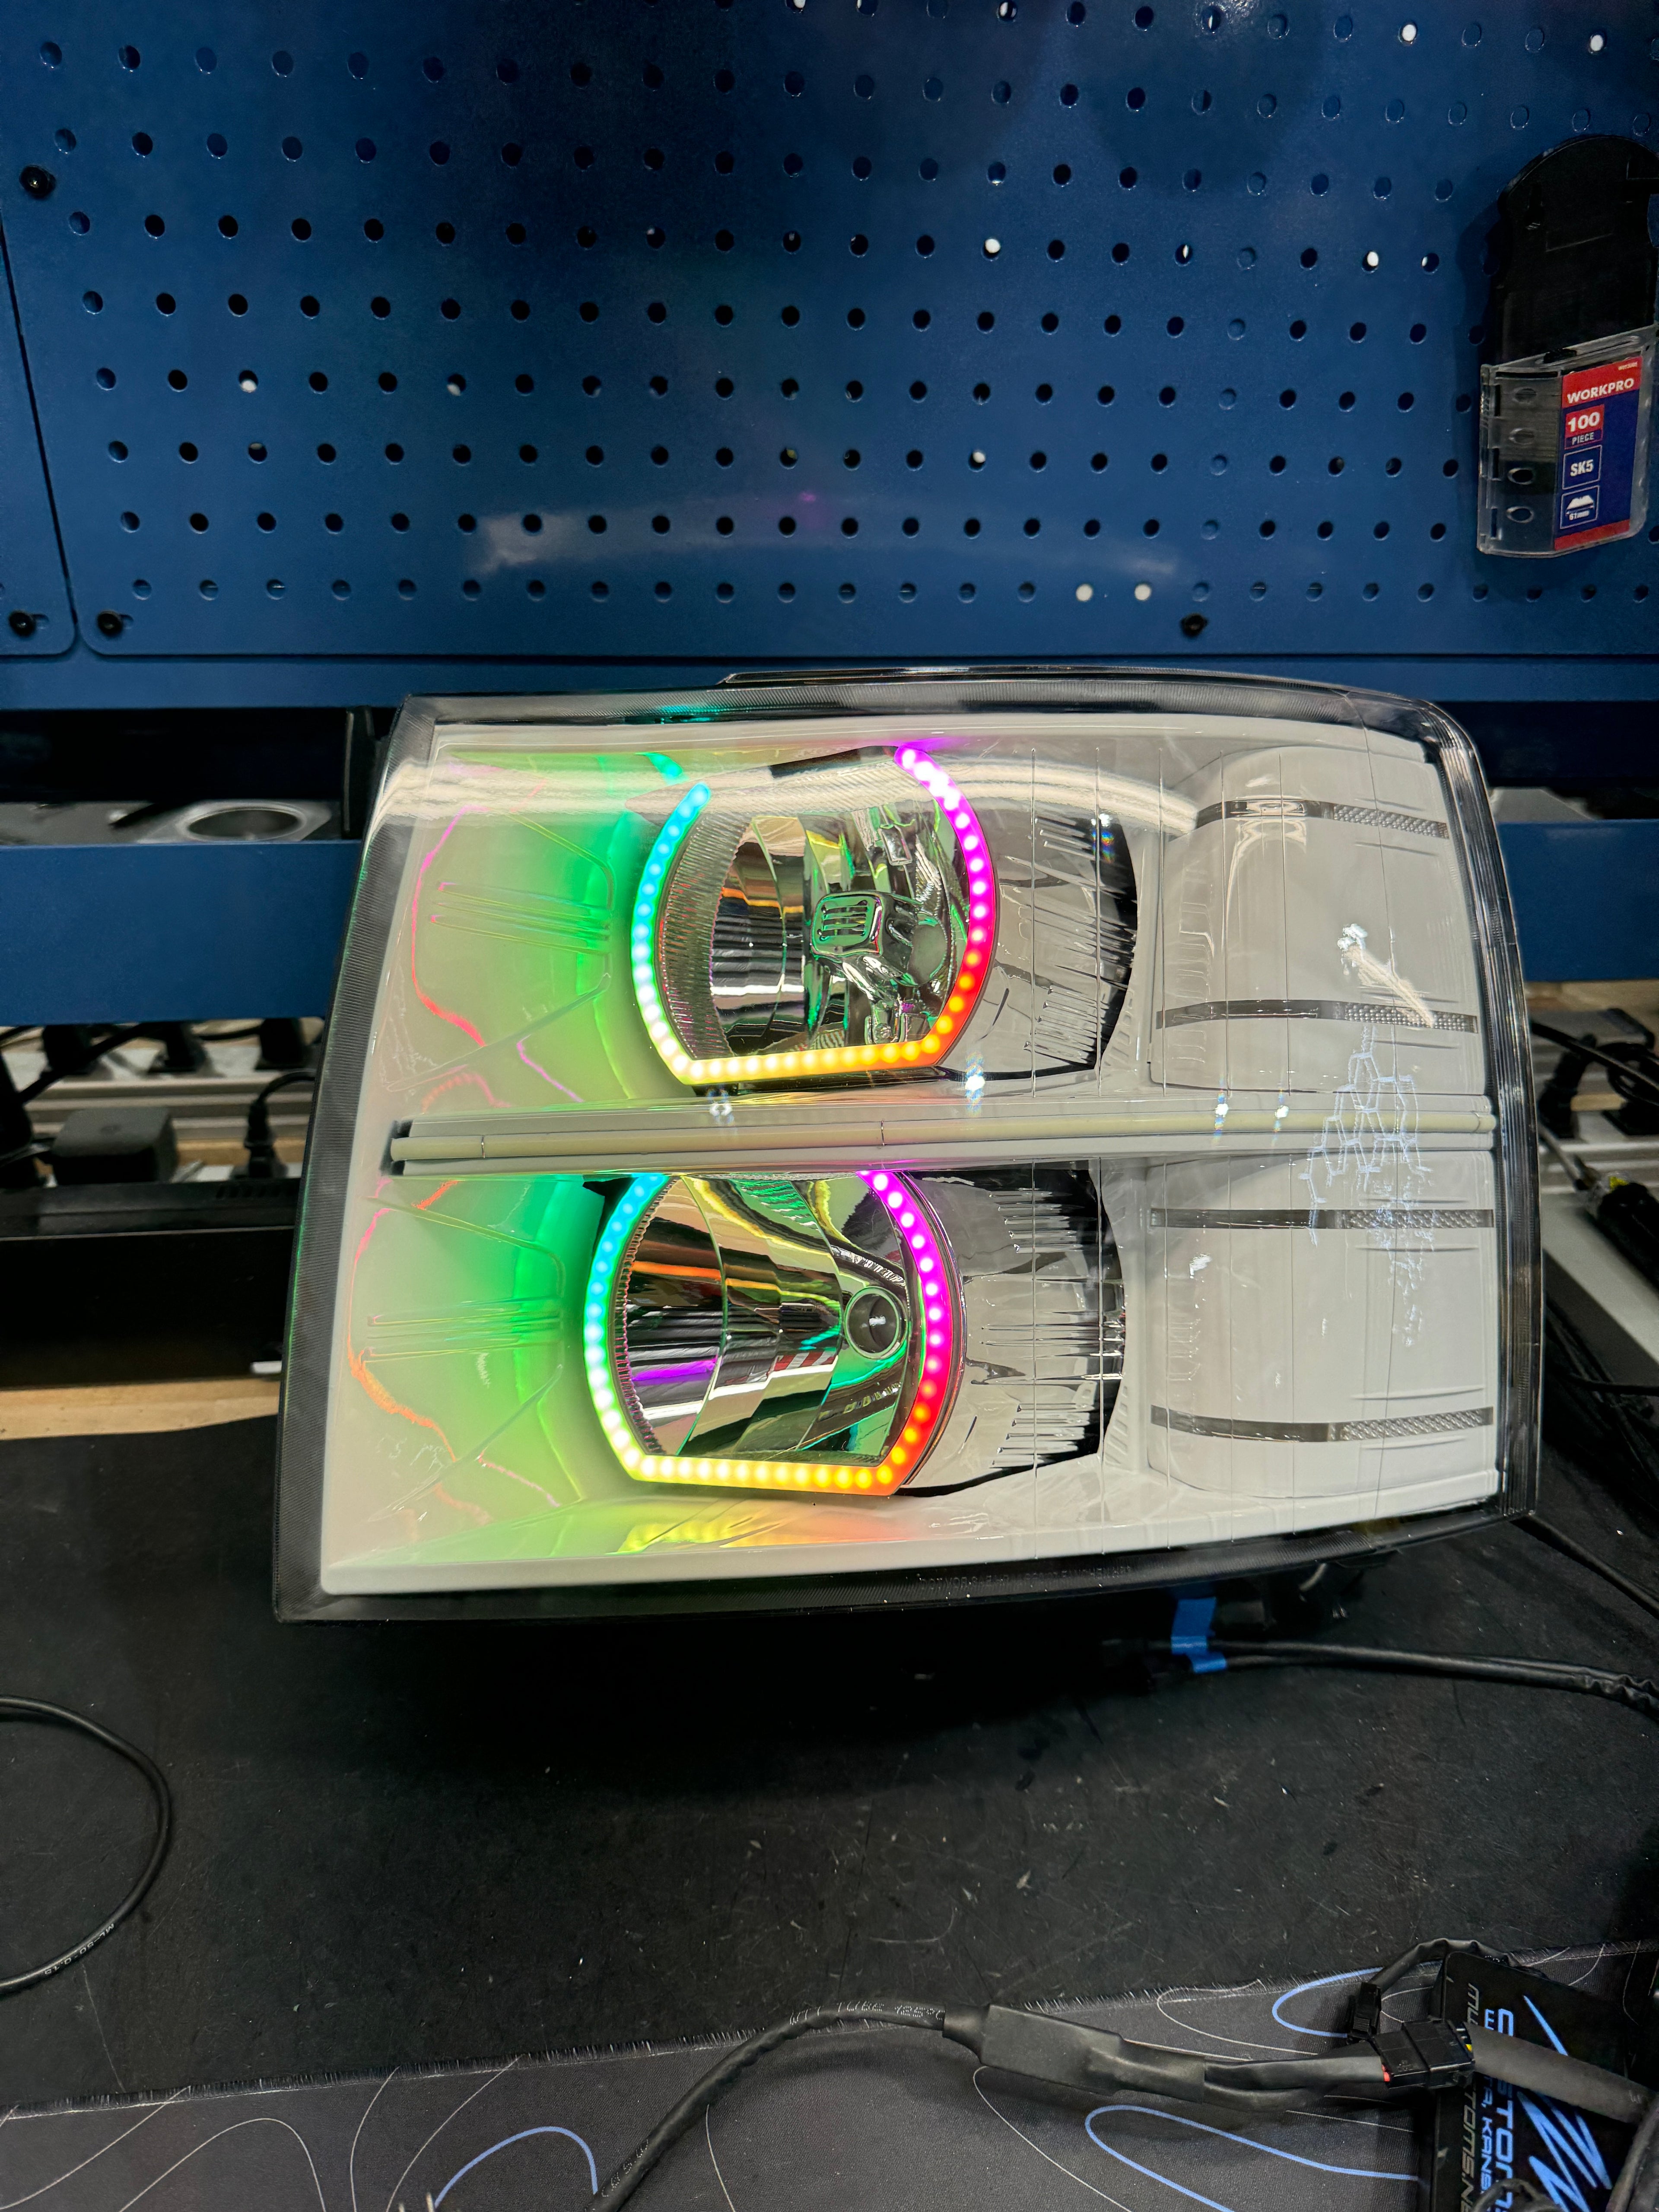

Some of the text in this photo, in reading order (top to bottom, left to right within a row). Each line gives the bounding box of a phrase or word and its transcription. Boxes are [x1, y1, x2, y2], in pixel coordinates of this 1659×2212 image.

[1567, 378, 1634, 404] WORKPRO
[1568, 411, 1600, 432] 100
[1571, 432, 1594, 445] PIECE
[1570, 459, 1594, 477] SK5
